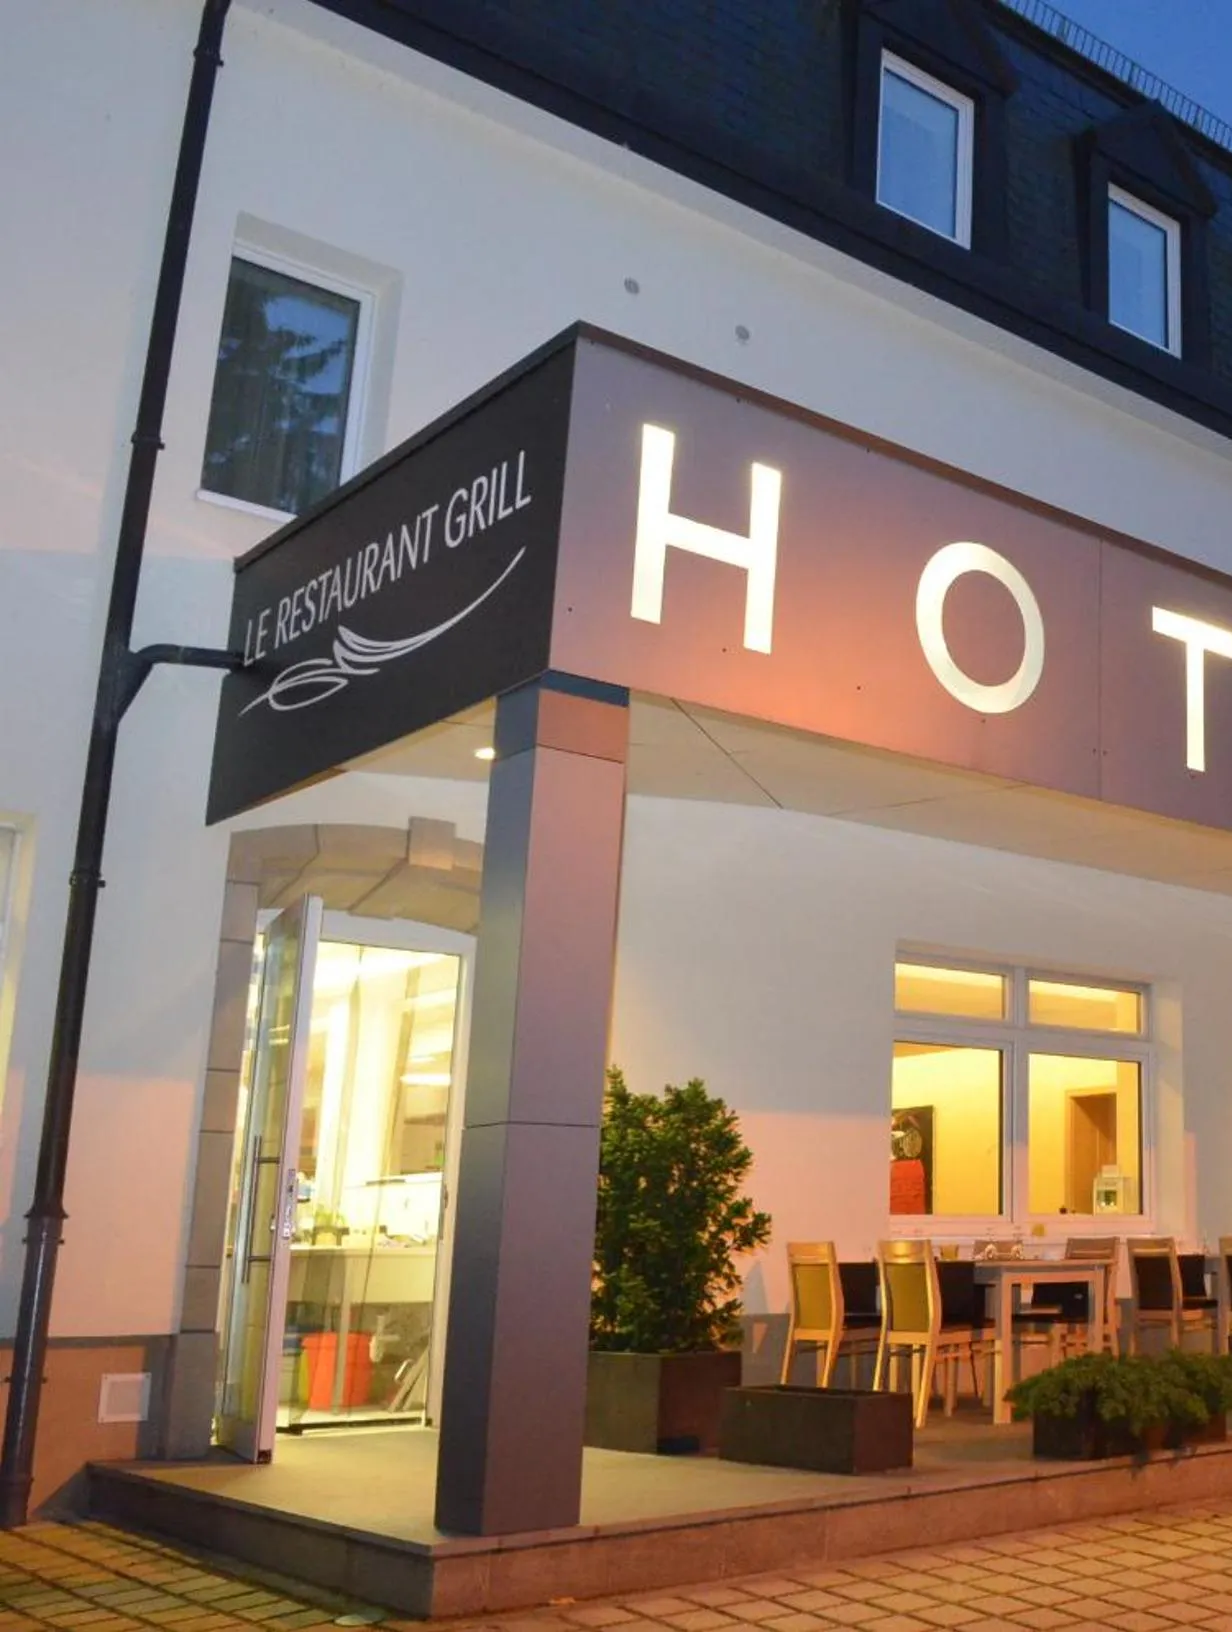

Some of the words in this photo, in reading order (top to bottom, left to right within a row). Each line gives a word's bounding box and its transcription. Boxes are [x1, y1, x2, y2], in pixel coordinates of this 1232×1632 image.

[243, 607, 272, 667] LE
[274, 504, 440, 650] RESTAURANT
[444, 449, 532, 549] GRILL
